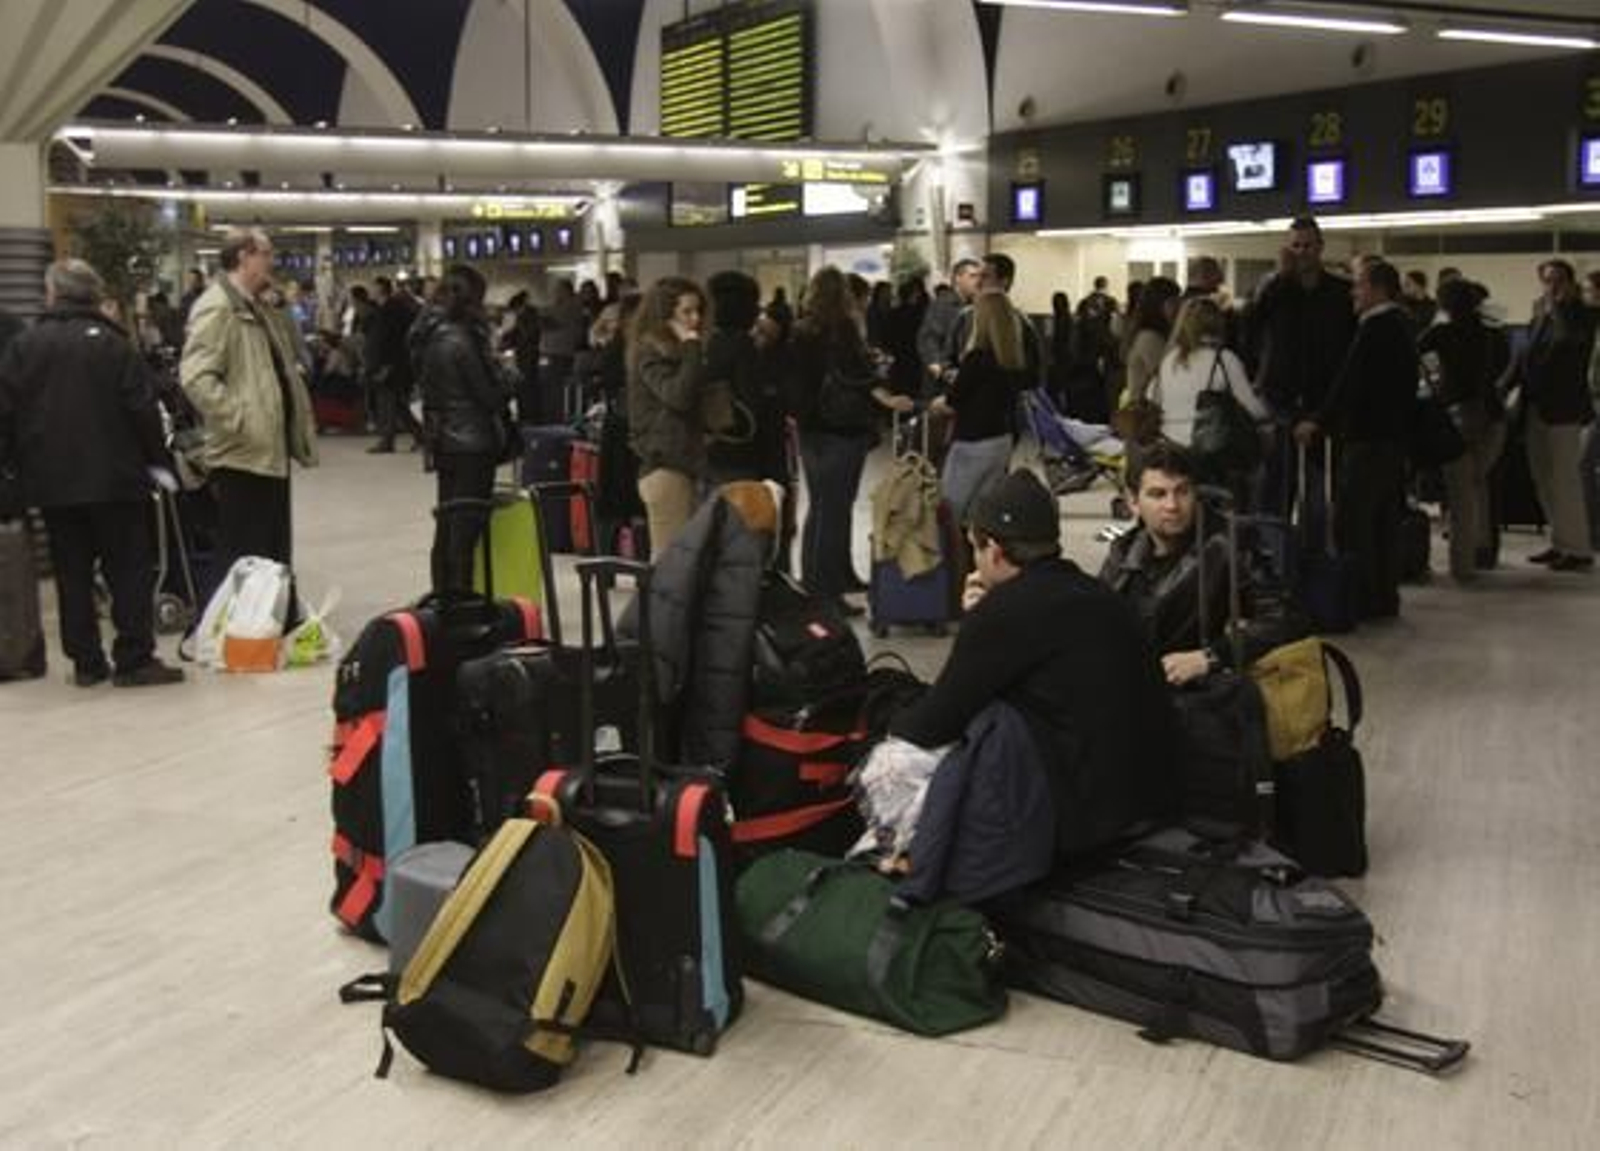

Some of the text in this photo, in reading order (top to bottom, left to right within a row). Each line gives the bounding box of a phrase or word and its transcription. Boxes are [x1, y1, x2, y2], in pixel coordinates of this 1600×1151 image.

[1310, 112, 1341, 146] 28
[1414, 98, 1447, 135] 29
[1187, 128, 1211, 160] 27
